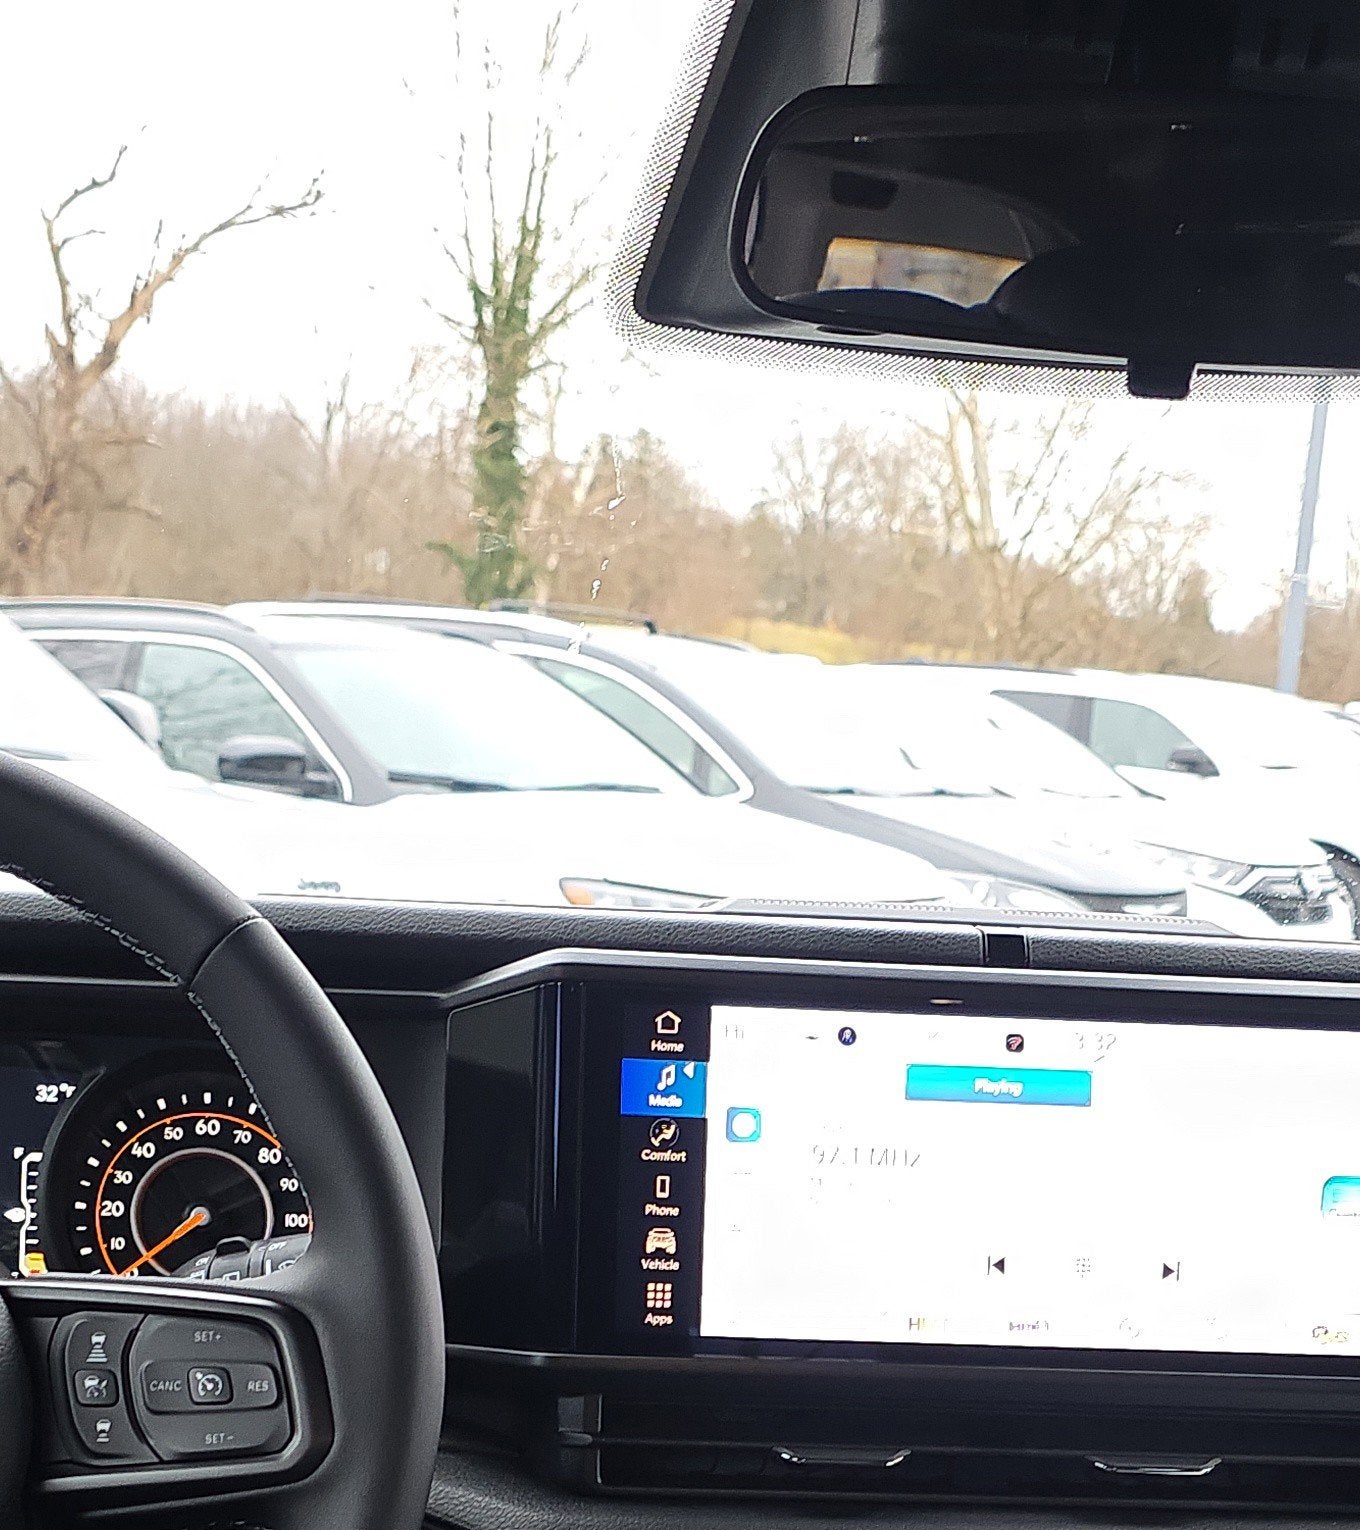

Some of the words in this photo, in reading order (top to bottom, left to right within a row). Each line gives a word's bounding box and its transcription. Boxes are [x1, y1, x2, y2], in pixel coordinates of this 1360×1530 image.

[650, 1039, 684, 1053] Home
[972, 1076, 1025, 1099] Playing
[648, 1093, 683, 1108] Media
[163, 1127, 184, 1141] 50
[194, 1118, 221, 1136] 60
[232, 1129, 253, 1145] 70
[130, 1141, 156, 1159] 40
[257, 1148, 282, 1165] 80
[640, 1148, 687, 1164] Comfort
[113, 1170, 133, 1184] 30
[279, 1177, 299, 1192] 90
[101, 1201, 125, 1217] 20
[644, 1202, 680, 1218] Phone
[284, 1213, 309, 1228] 100
[109, 1237, 126, 1251] 10
[640, 1257, 680, 1271] Vehicle
[643, 1312, 673, 1327] Apps
[193, 1331, 223, 1343] SET+
[149, 1379, 183, 1393] CANC
[246, 1380, 270, 1393] RES
